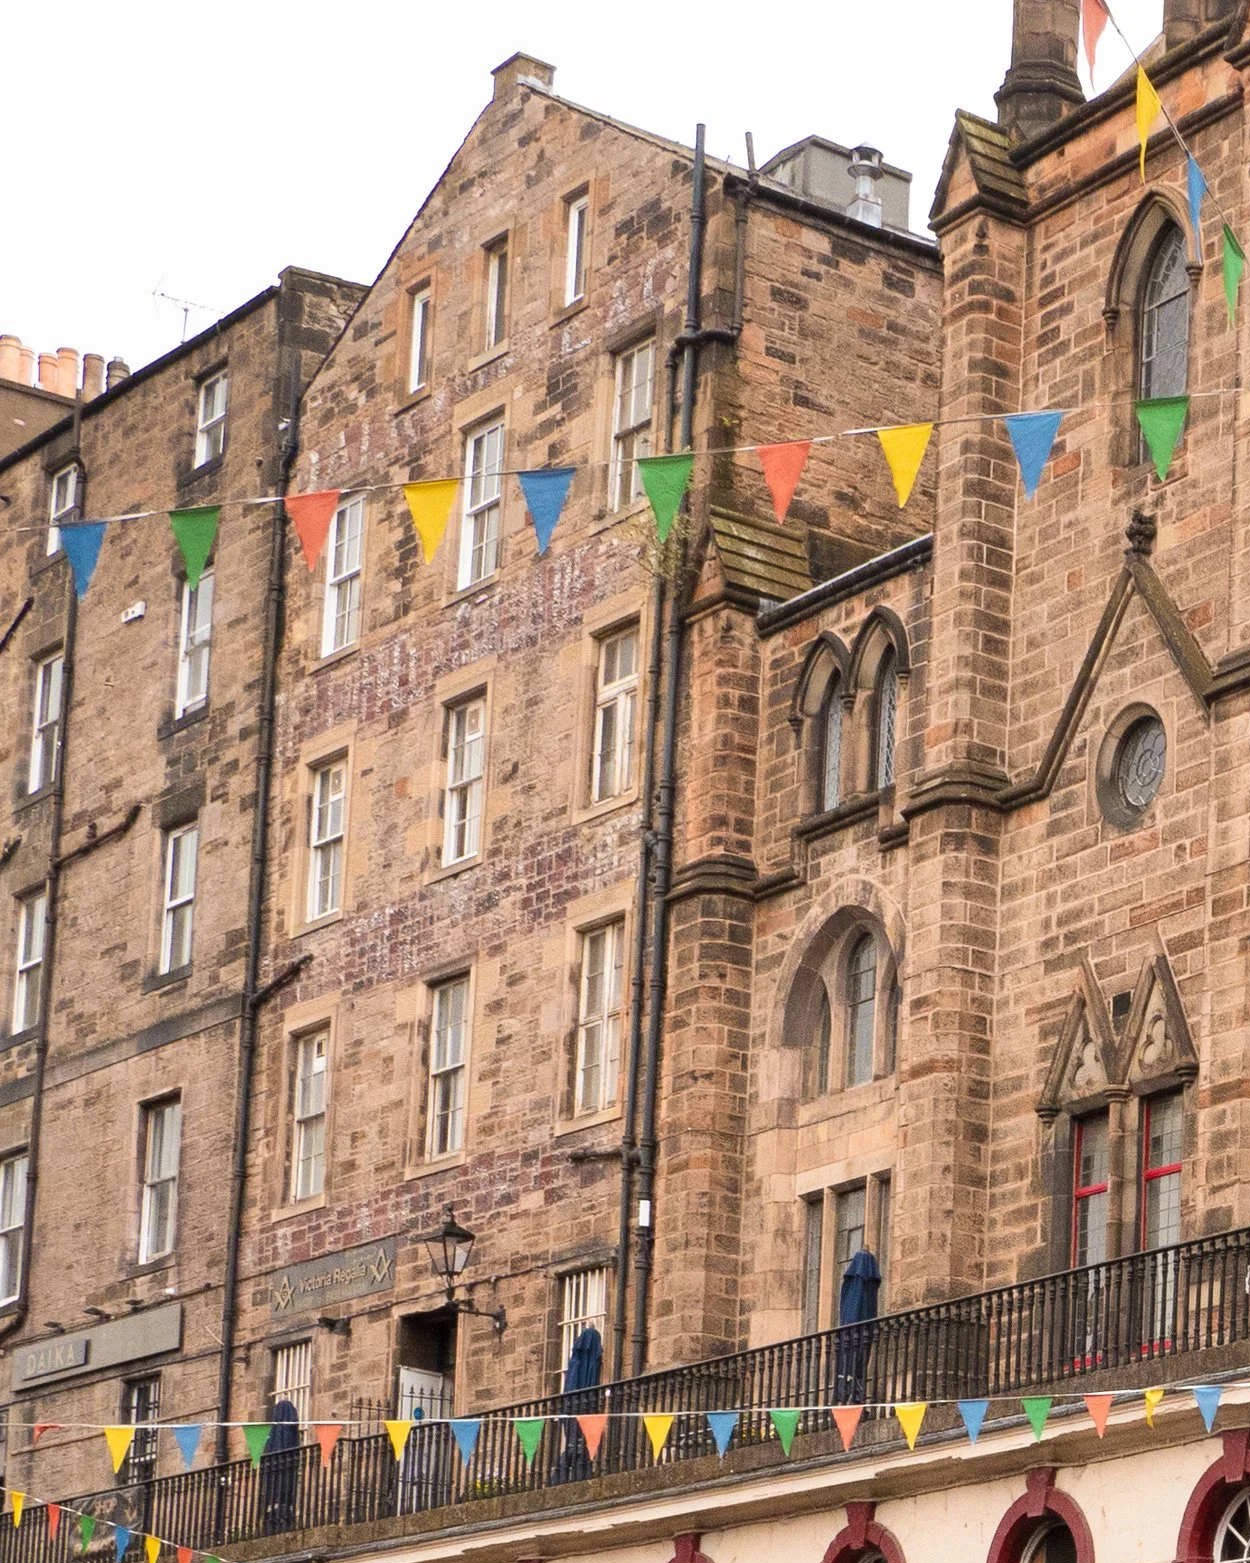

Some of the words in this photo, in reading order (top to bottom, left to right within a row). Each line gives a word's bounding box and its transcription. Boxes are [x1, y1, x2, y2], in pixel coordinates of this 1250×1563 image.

[299, 1271, 332, 1294] Victoria
[333, 1263, 367, 1286] Regalia
[26, 1343, 76, 1375] DAIKA
